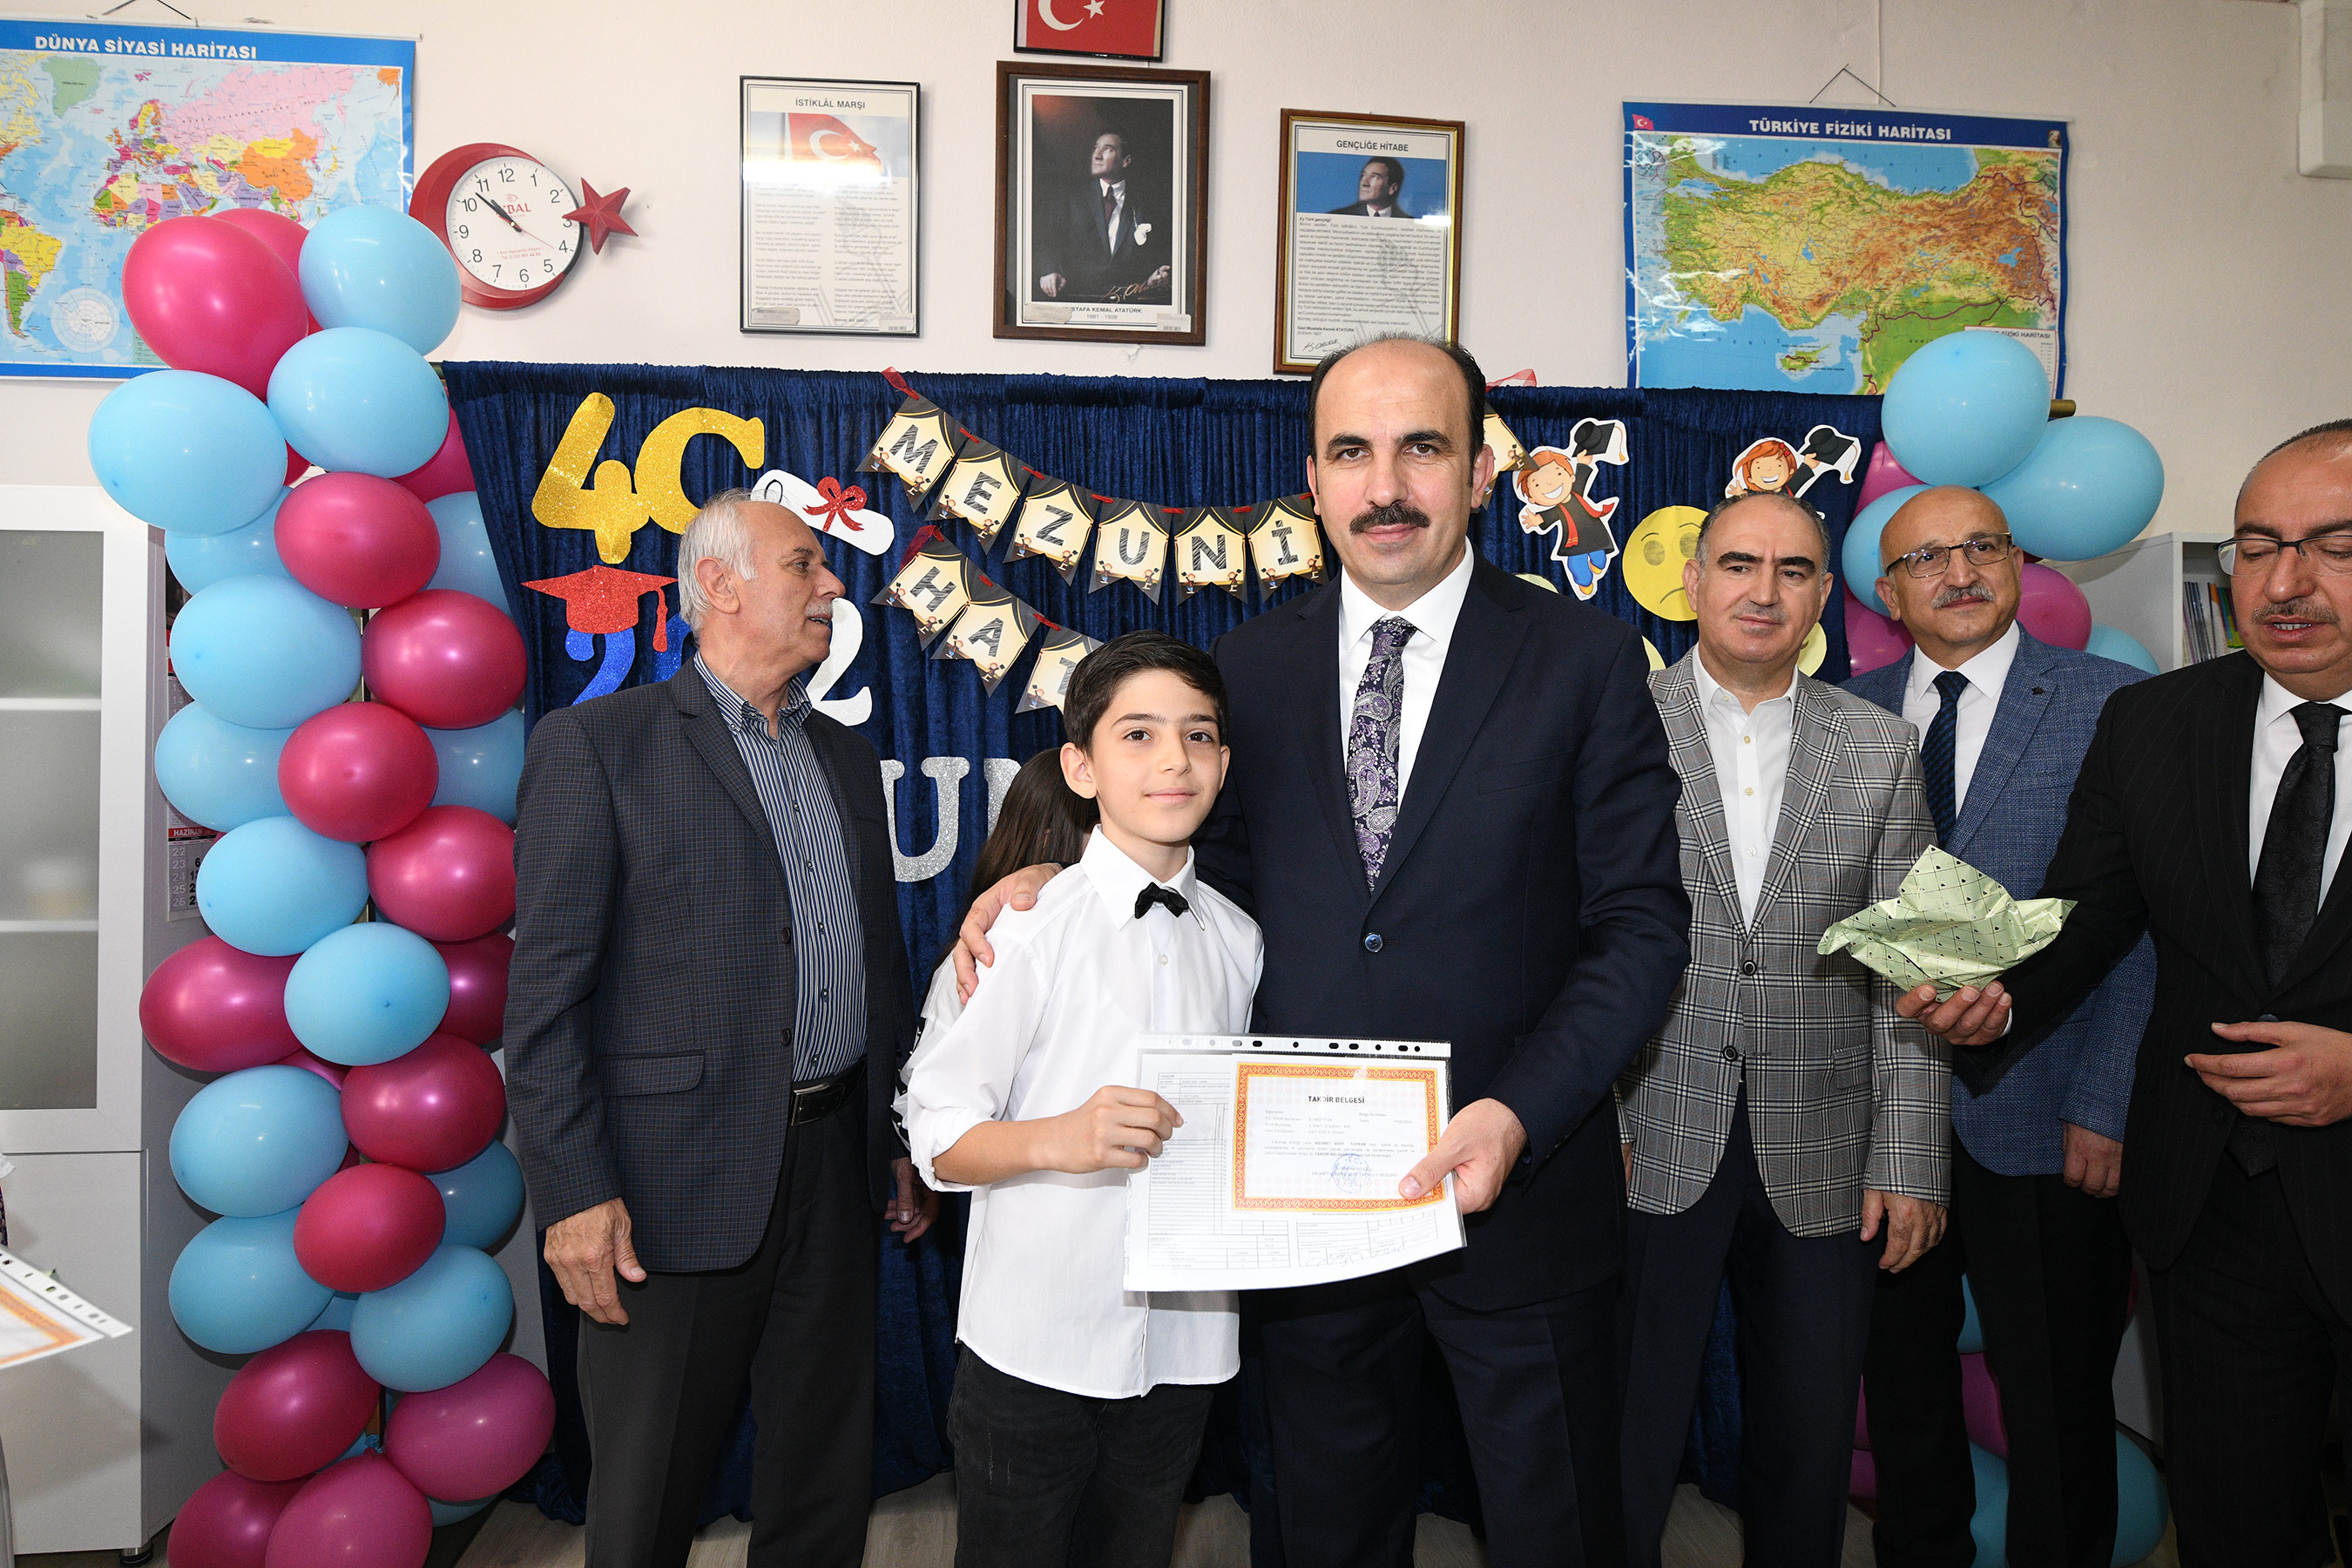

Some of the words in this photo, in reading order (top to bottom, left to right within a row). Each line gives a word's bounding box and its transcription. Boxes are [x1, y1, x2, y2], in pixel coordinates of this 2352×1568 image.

[35, 33, 100, 53] DÜNYA
[104, 37, 166, 57] SİYASİ
[171, 40, 257, 60] HARİTASI
[794, 97, 835, 109] İSTİKLÂL
[836, 99, 867, 110] MARŞI
[1748, 118, 1821, 136] TÜRKİYE
[1825, 119, 1873, 138] FİZİKİ
[1877, 122, 1951, 140] HARİTASI
[1335, 139, 1378, 151] GENÇLİĞE
[1379, 141, 1409, 152] HİTABE
[497, 168, 516, 183] 12
[530, 173, 537, 187] 1
[476, 179, 490, 193] 11
[550, 189, 560, 204] 2
[461, 198, 478, 213] 10
[458, 224, 470, 239] 9
[558, 240, 569, 253] 4
[472, 249, 483, 263] 8
[492, 264, 502, 279] 7
[543, 259, 554, 274] 5
[519, 268, 530, 283] 6
[173, 828, 203, 837] HAZİRAN
[172, 847, 186, 856] 22
[172, 859, 186, 869] 23
[172, 872, 186, 882] 24
[172, 884, 186, 894] 25
[172, 897, 186, 907] 26
[1308, 1094, 1334, 1103] TAKDİR
[1335, 1095, 1366, 1104] BELGESİ
